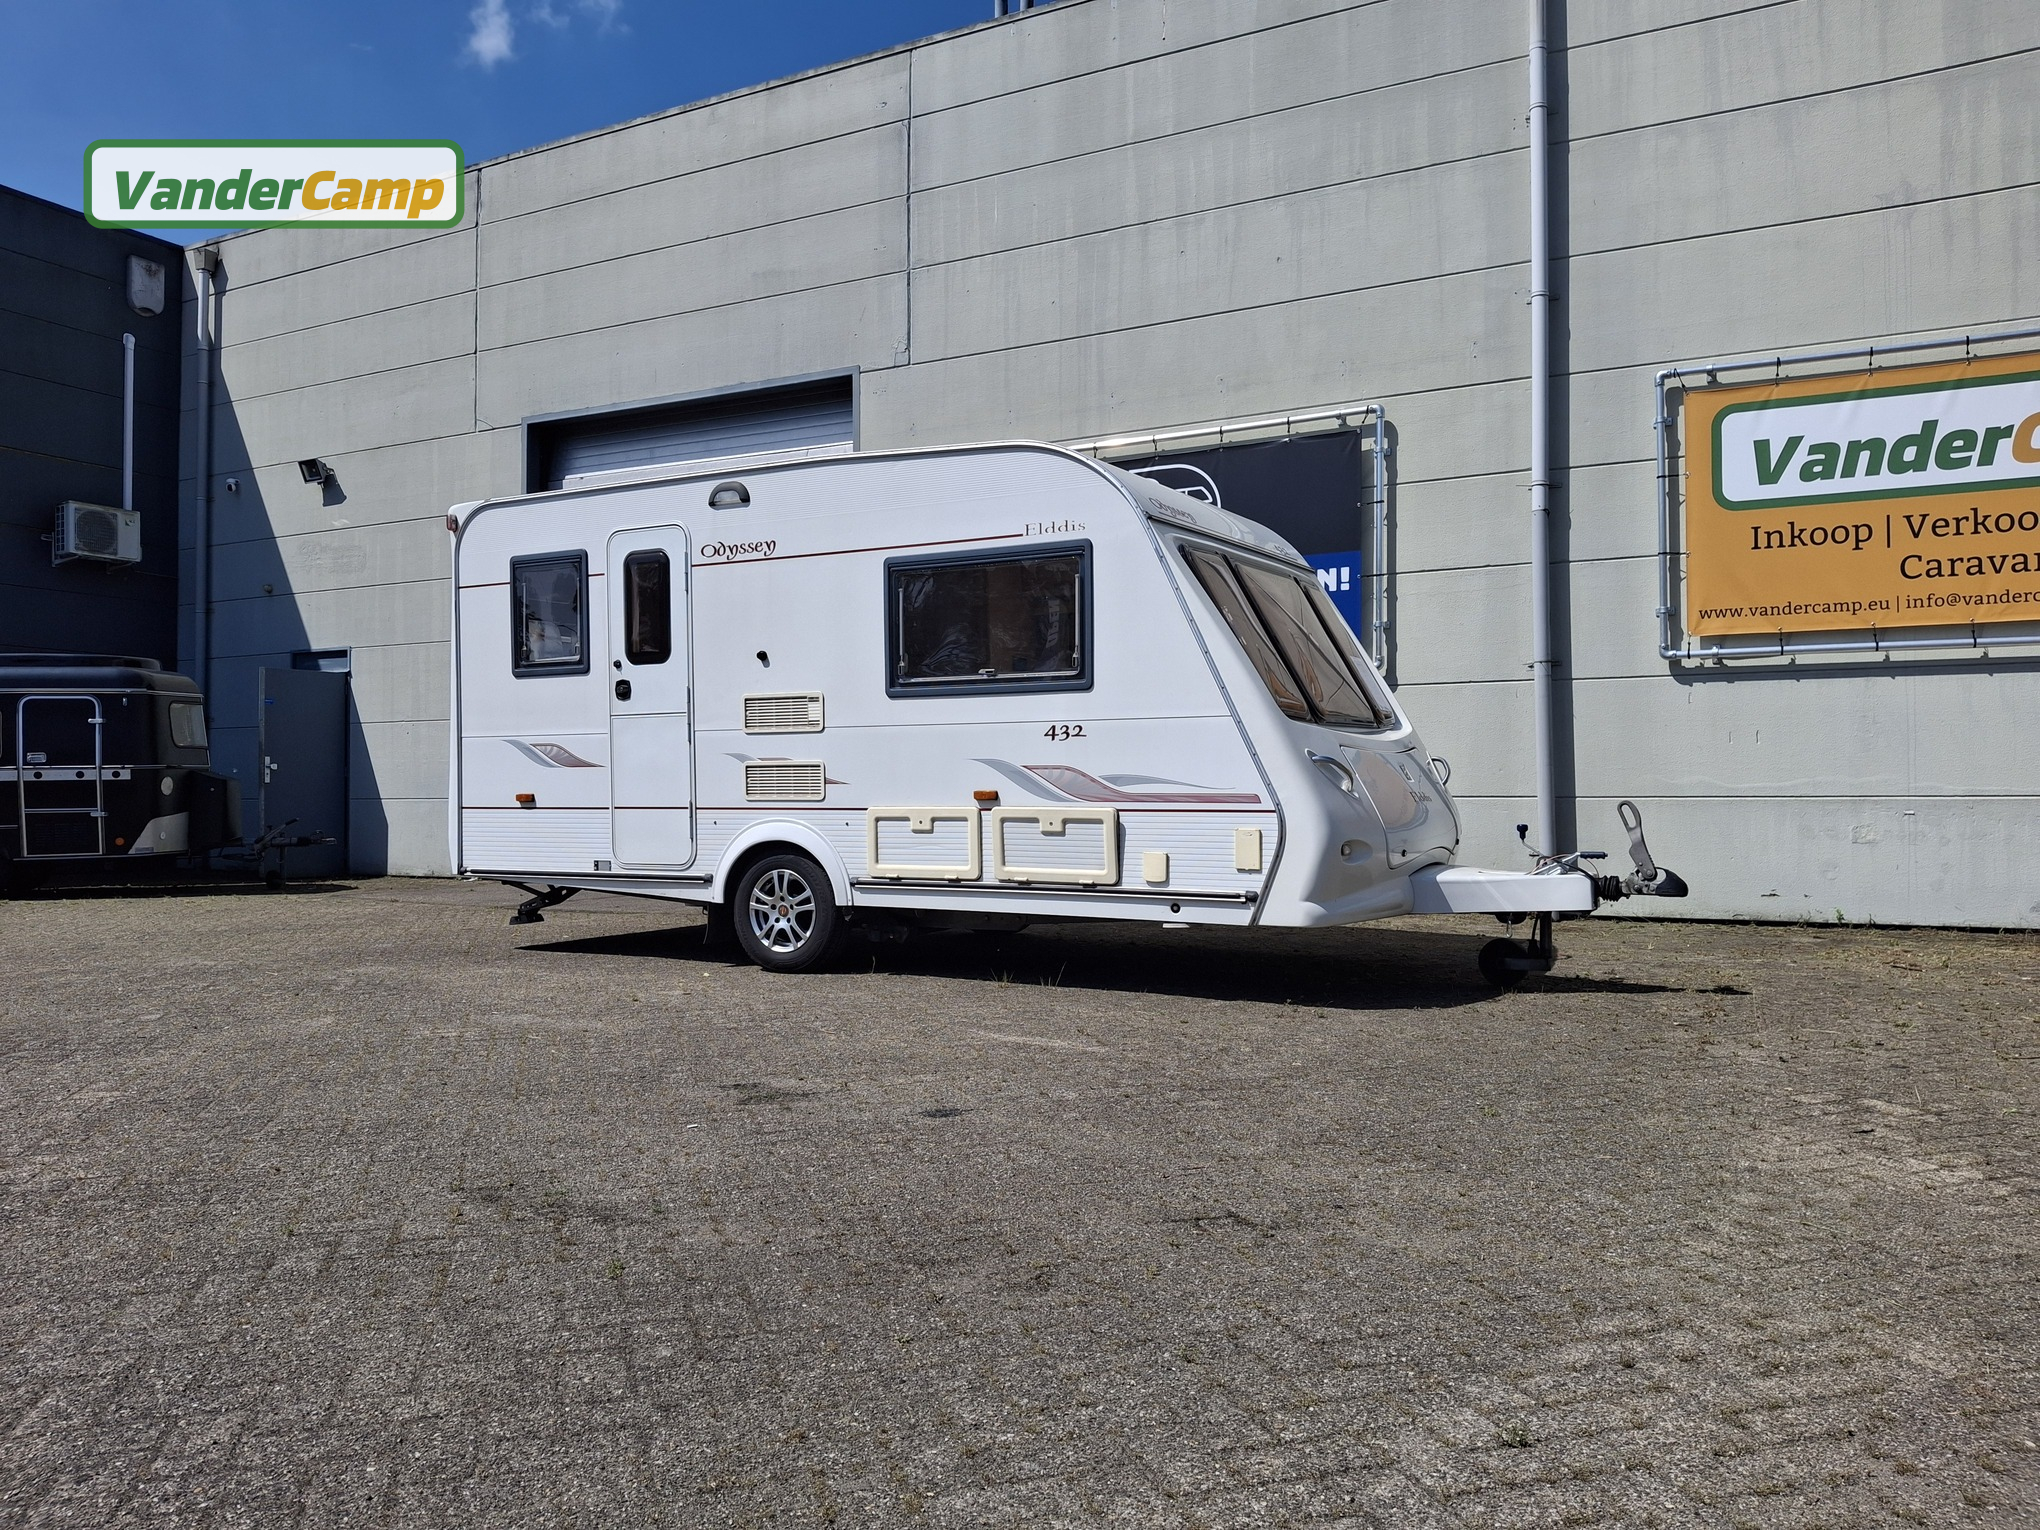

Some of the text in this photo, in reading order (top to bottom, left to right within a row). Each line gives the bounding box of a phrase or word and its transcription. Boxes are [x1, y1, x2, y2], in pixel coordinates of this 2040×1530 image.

[1024, 520, 1086, 537] Elddis
[1750, 521, 1873, 551] Inkoop
[1902, 507, 2039, 539] Verkoo
[700, 540, 776, 561] Odyssey
[1699, 599, 1890, 620] www.vandercamp.eu
[1043, 724, 1087, 742] 432
